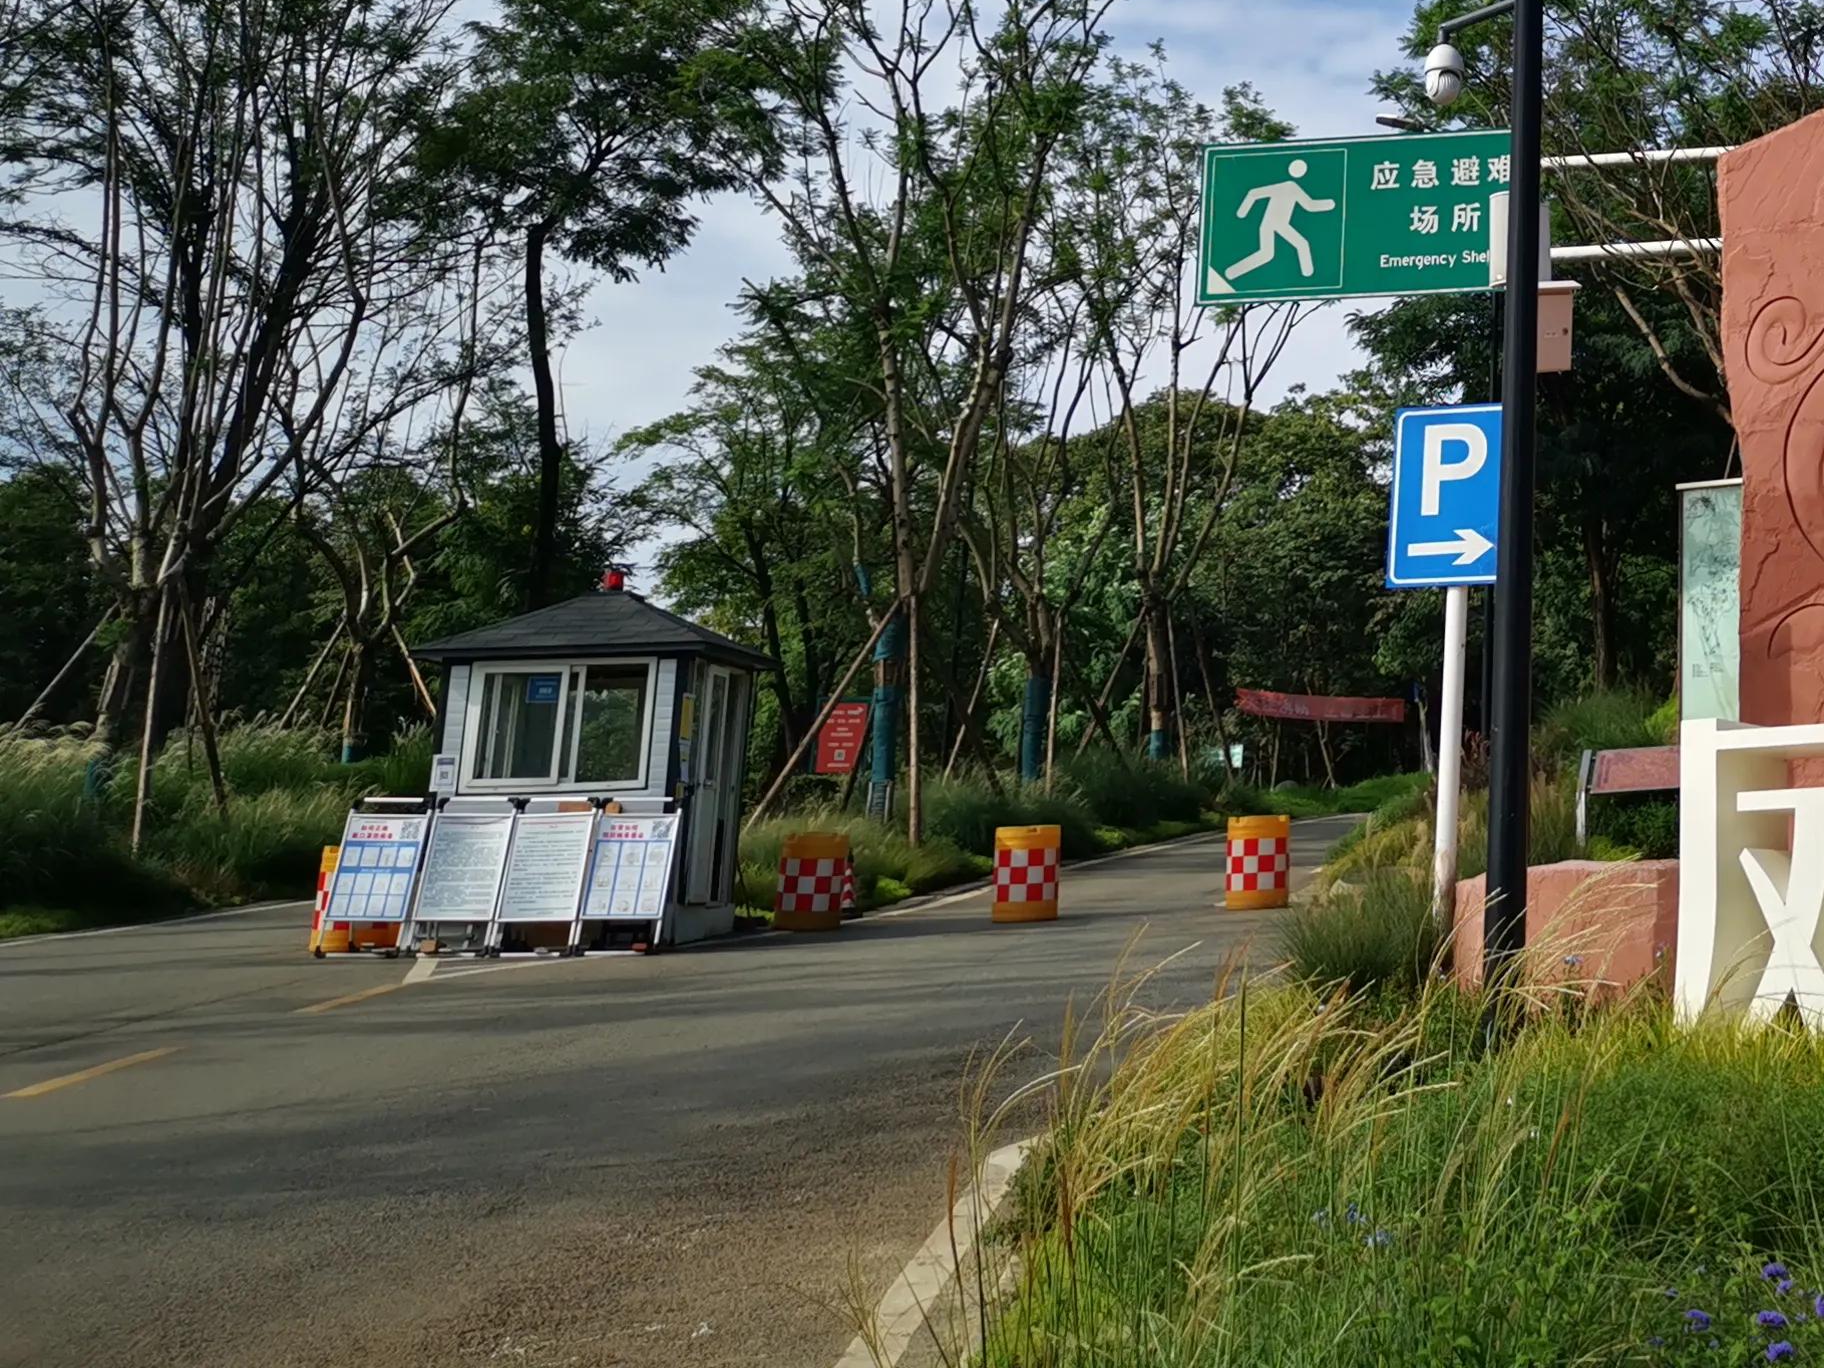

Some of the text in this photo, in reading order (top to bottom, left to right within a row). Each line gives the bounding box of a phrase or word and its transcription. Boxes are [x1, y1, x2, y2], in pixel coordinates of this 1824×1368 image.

[1370, 154, 1511, 190] 应急避难
[1409, 202, 1481, 234] 场所
[1380, 249, 1491, 270] Emergency Shel
[1420, 423, 1488, 517] P
